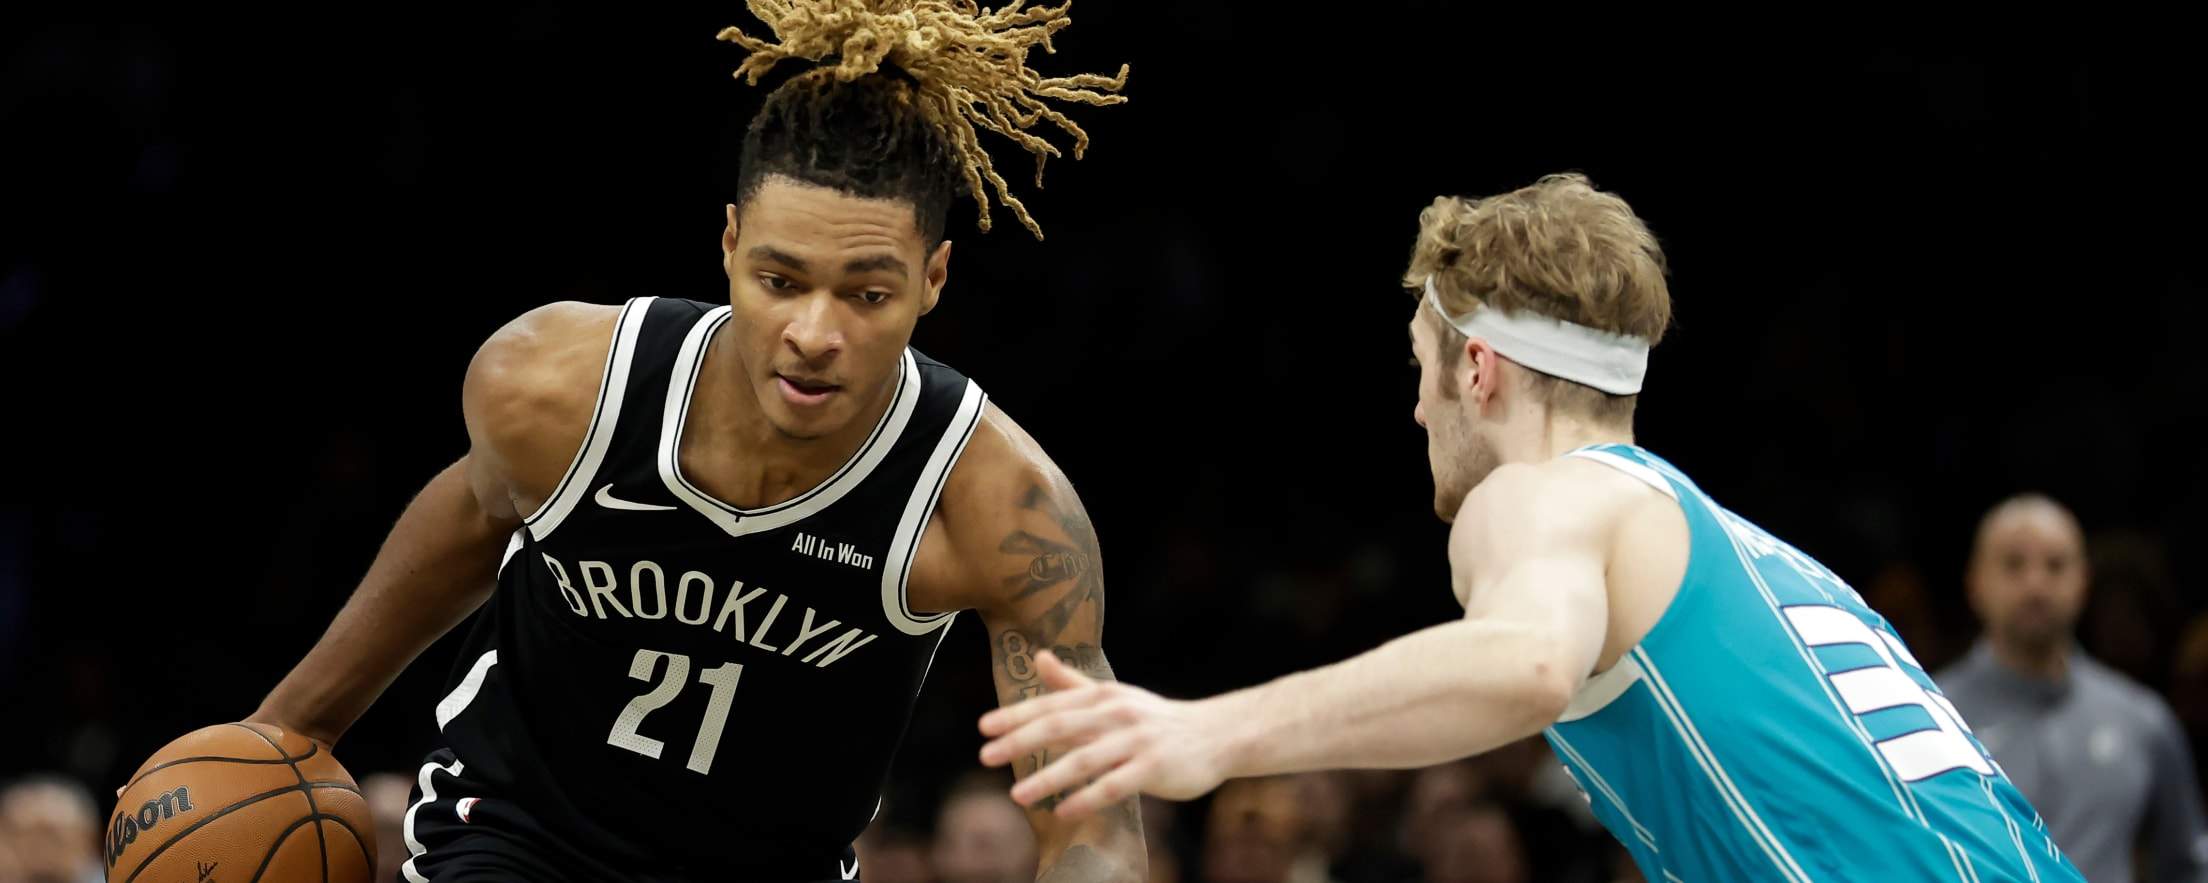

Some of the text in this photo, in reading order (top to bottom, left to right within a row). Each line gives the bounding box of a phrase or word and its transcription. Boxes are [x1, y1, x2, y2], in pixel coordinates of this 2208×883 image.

[541, 551, 879, 668] BROOKLYN
[791, 532, 873, 570] All In Won
[606, 648, 744, 776] 21
